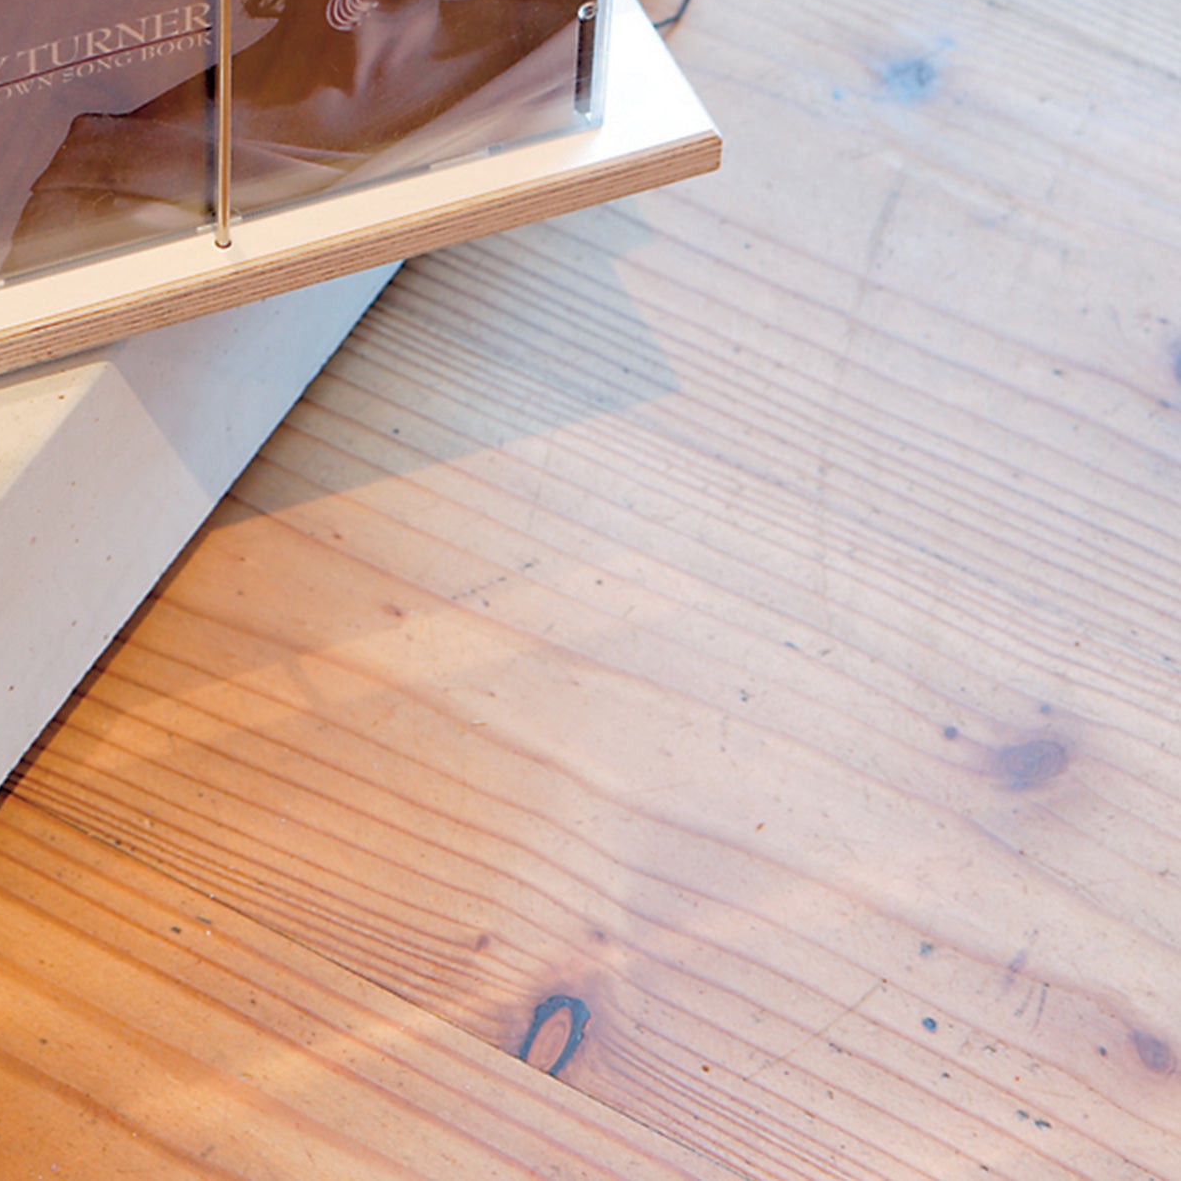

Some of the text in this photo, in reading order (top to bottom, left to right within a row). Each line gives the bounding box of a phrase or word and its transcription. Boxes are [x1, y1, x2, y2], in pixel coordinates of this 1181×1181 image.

[17, 3, 212, 74] TURNER
[62, 55, 133, 83] SONG
[140, 32, 212, 62] BOOK
